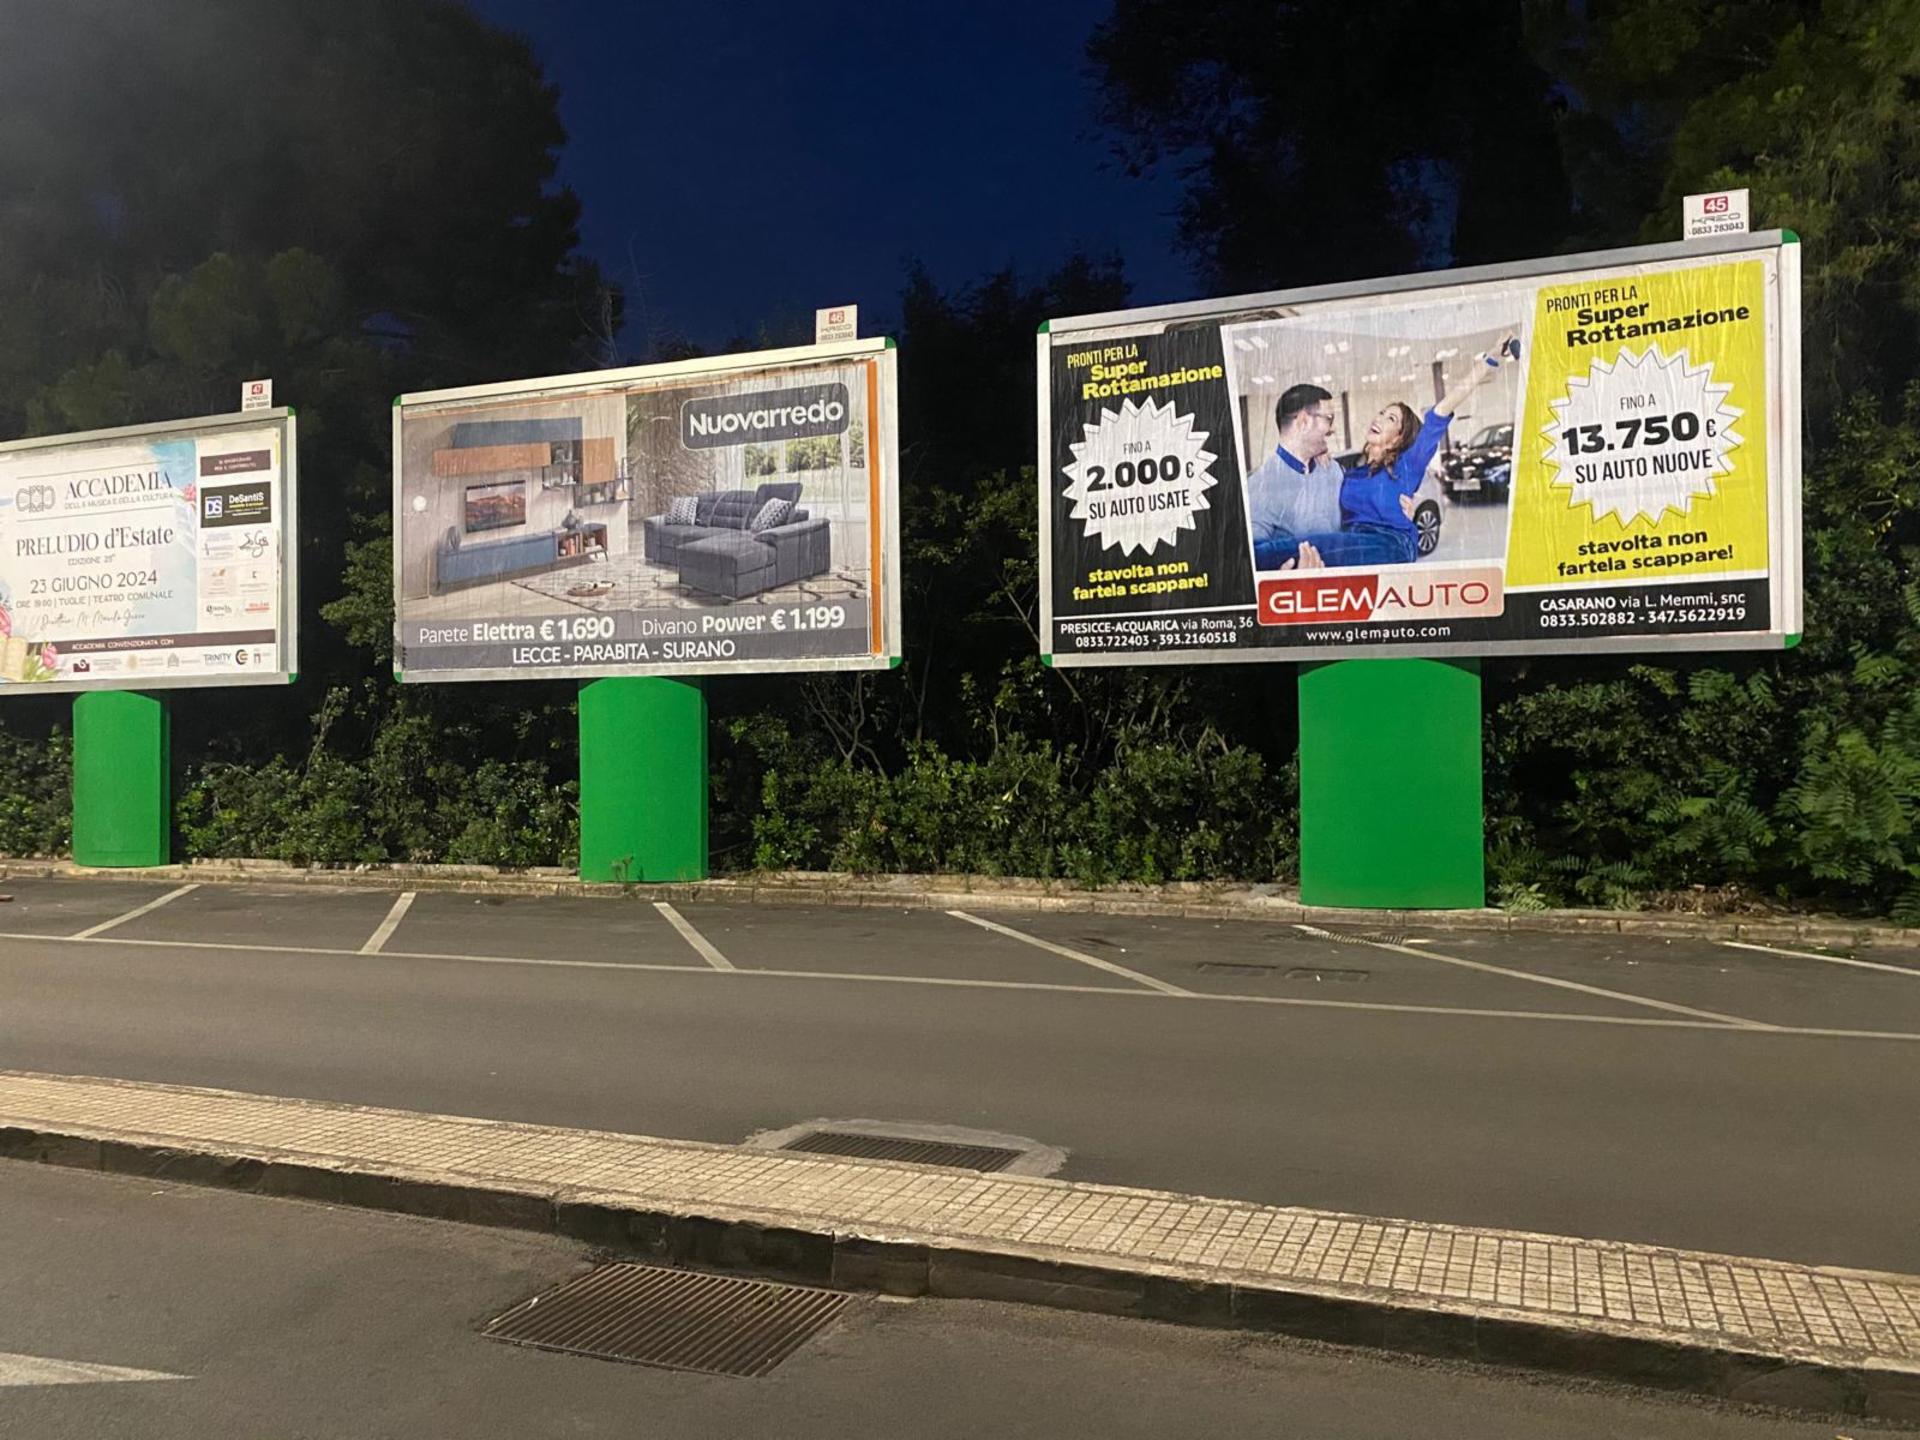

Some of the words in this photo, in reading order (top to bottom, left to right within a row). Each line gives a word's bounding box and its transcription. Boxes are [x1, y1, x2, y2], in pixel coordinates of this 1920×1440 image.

[1705, 197, 1727, 212] 45
[1692, 226, 1711, 235] 0833
[1546, 293, 1591, 313] PRONTI
[1594, 289, 1618, 308] PER
[1621, 285, 1638, 300] LA
[1567, 305, 1750, 347] Rottamazione
[1577, 302, 1649, 326] Super
[1067, 351, 1102, 368] PRONTI
[1104, 346, 1123, 363] PER
[1125, 344, 1138, 357] LA
[1082, 364, 1223, 399] Rottamazione
[1091, 359, 1148, 381] Super
[1620, 395, 1645, 410] FINO
[1648, 394, 1656, 407] A
[690, 400, 844, 437] Nuovarredo
[1561, 412, 1699, 456] 13.750
[1706, 419, 1717, 438] €
[1123, 441, 1143, 454] FINO
[1145, 440, 1151, 452] A
[1086, 455, 1181, 492] 2.000
[1185, 461, 1195, 479] €
[1575, 464, 1597, 484] SU
[1602, 457, 1647, 481] AUTO
[1653, 450, 1713, 475] NUOVE
[65, 471, 174, 499] ACCADEMIA
[1089, 499, 1106, 520] SU
[1110, 494, 1146, 517] AUTO
[1149, 489, 1191, 511] USATE
[16, 533, 99, 557] PRELUDIO
[104, 525, 173, 550] d'Estate
[1578, 534, 1661, 556] stavolta
[1667, 531, 1708, 547] non
[1088, 564, 1154, 583] stavolta
[1157, 561, 1188, 575] non
[1557, 554, 1626, 576] fartela
[1632, 544, 1733, 570] scappare!
[30, 578, 47, 594] 23
[51, 574, 113, 593] GIUGNO
[117, 570, 157, 588] 2024
[1073, 582, 1126, 600] fartela
[1130, 573, 1208, 596] scappare!
[93, 594, 125, 604] TEATRO
[128, 590, 173, 600] COMUNALE
[1540, 597, 1616, 611] CASARANO
[1619, 597, 1640, 608] via
[1645, 595, 1657, 607] L.
[1660, 592, 1718, 608] Memmi,
[1721, 592, 1745, 604] snc
[419, 627, 468, 643] Parete
[473, 622, 535, 642] Elettra
[557, 616, 615, 641] 1.690
[642, 619, 697, 636] Divano
[702, 614, 766, 633] Power
[789, 605, 845, 630] 1.199
[1060, 619, 1179, 634] PRESICCE-ACQUARICA
[1181, 619, 1198, 630] via
[1201, 618, 1237, 632] Roma,
[1239, 616, 1253, 629] 36
[1540, 612, 1635, 628] 0833.502882
[1648, 609, 1746, 624] 347.5622919
[160, 638, 174, 647] CON
[1075, 635, 1149, 648] 0833.722403
[1159, 632, 1237, 646] 393.2160518
[1306, 625, 1451, 642] www.glemauto.com
[203, 653, 231, 662] TRINITY
[512, 647, 561, 664] LECCE
[574, 642, 650, 662] PARABITA
[663, 639, 735, 660] SURANO
